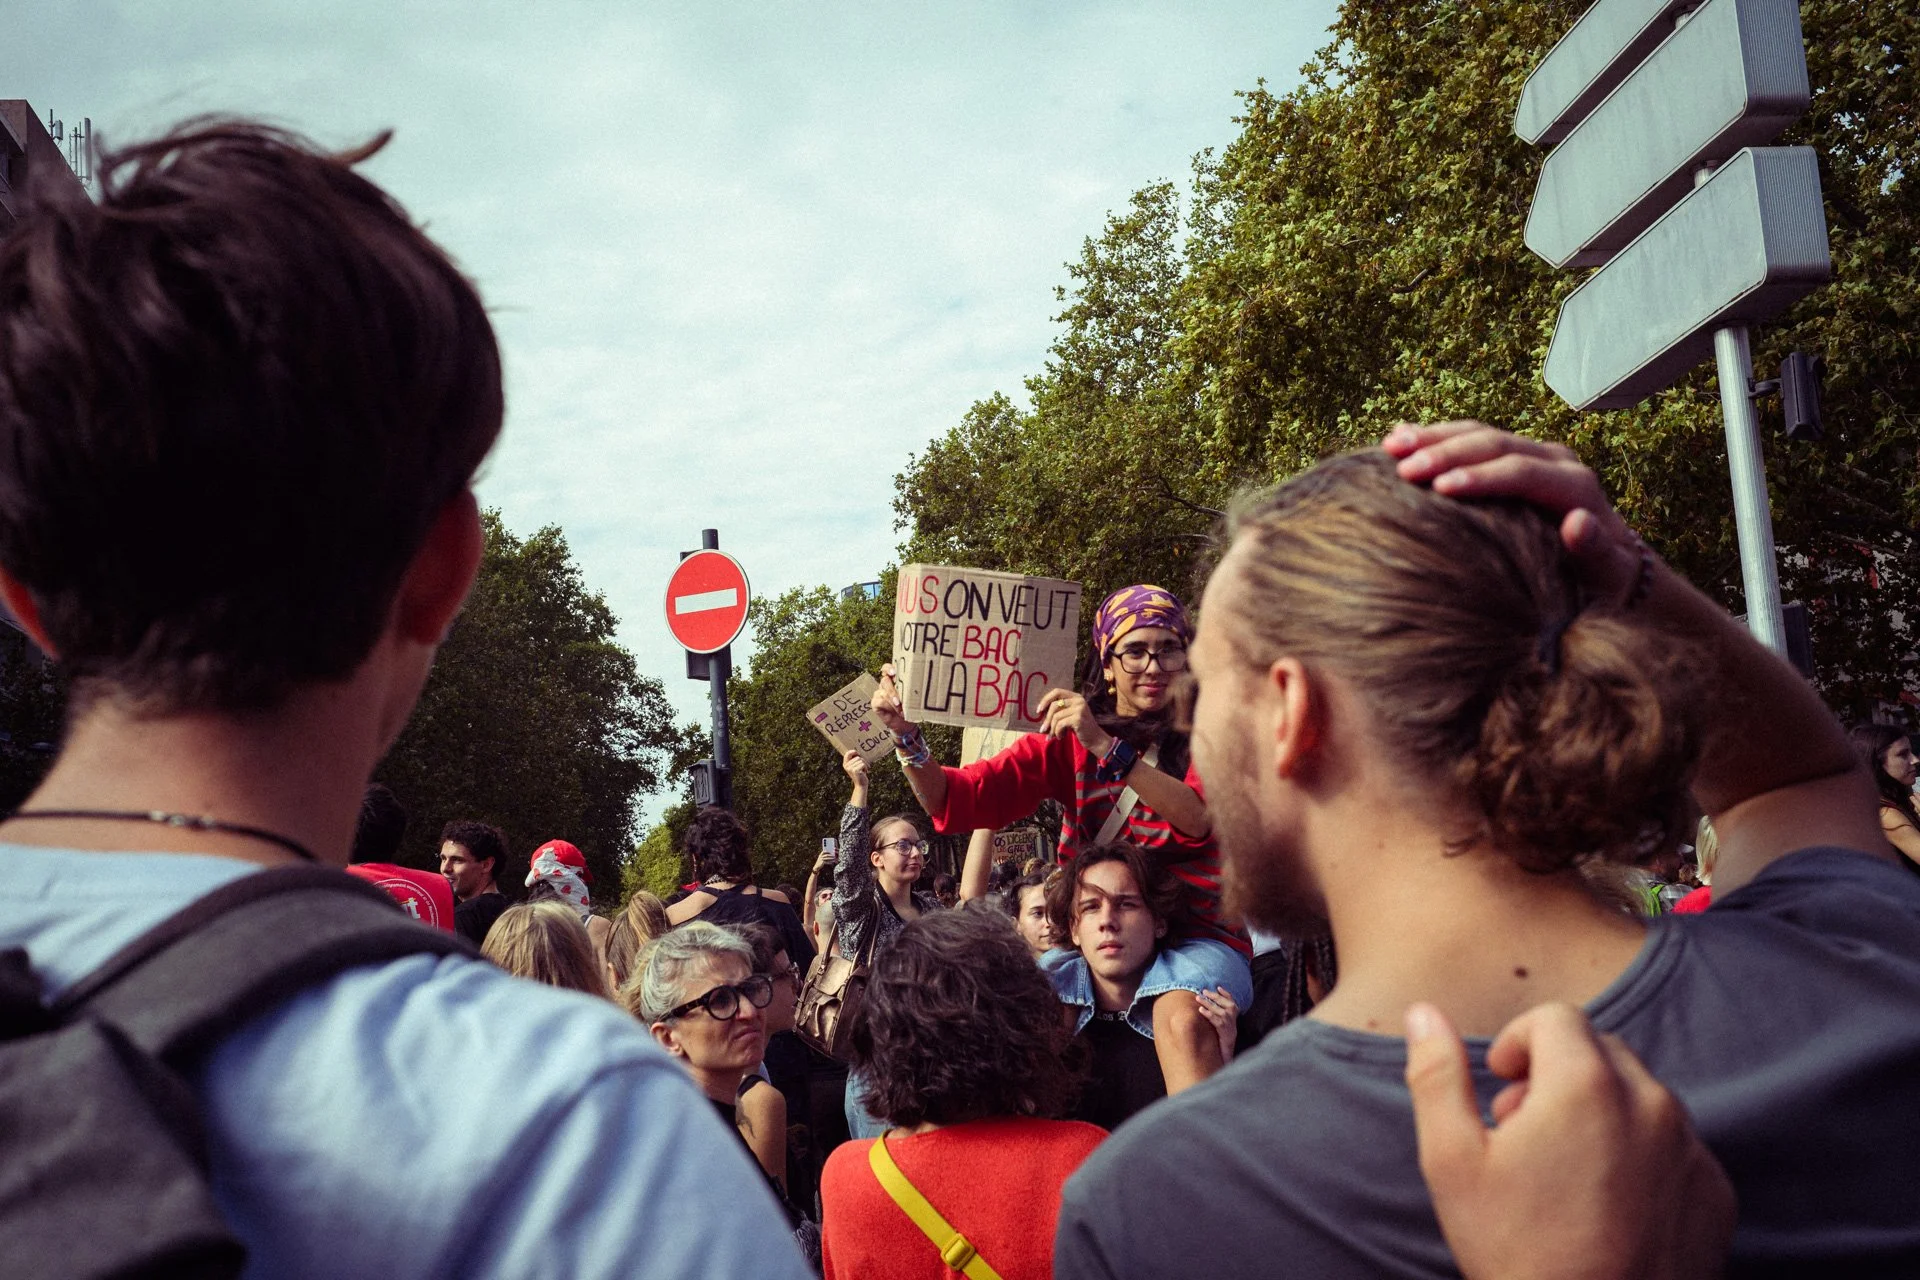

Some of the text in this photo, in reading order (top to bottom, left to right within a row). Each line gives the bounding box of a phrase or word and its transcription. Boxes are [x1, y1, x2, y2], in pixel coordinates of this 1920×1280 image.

[943, 579, 993, 622] ON
[998, 583, 1077, 630] VEUT
[901, 621, 1022, 667] OTRE BAC
[833, 689, 861, 712] DE
[923, 659, 968, 716] LA
[974, 664, 1049, 723] BAC
